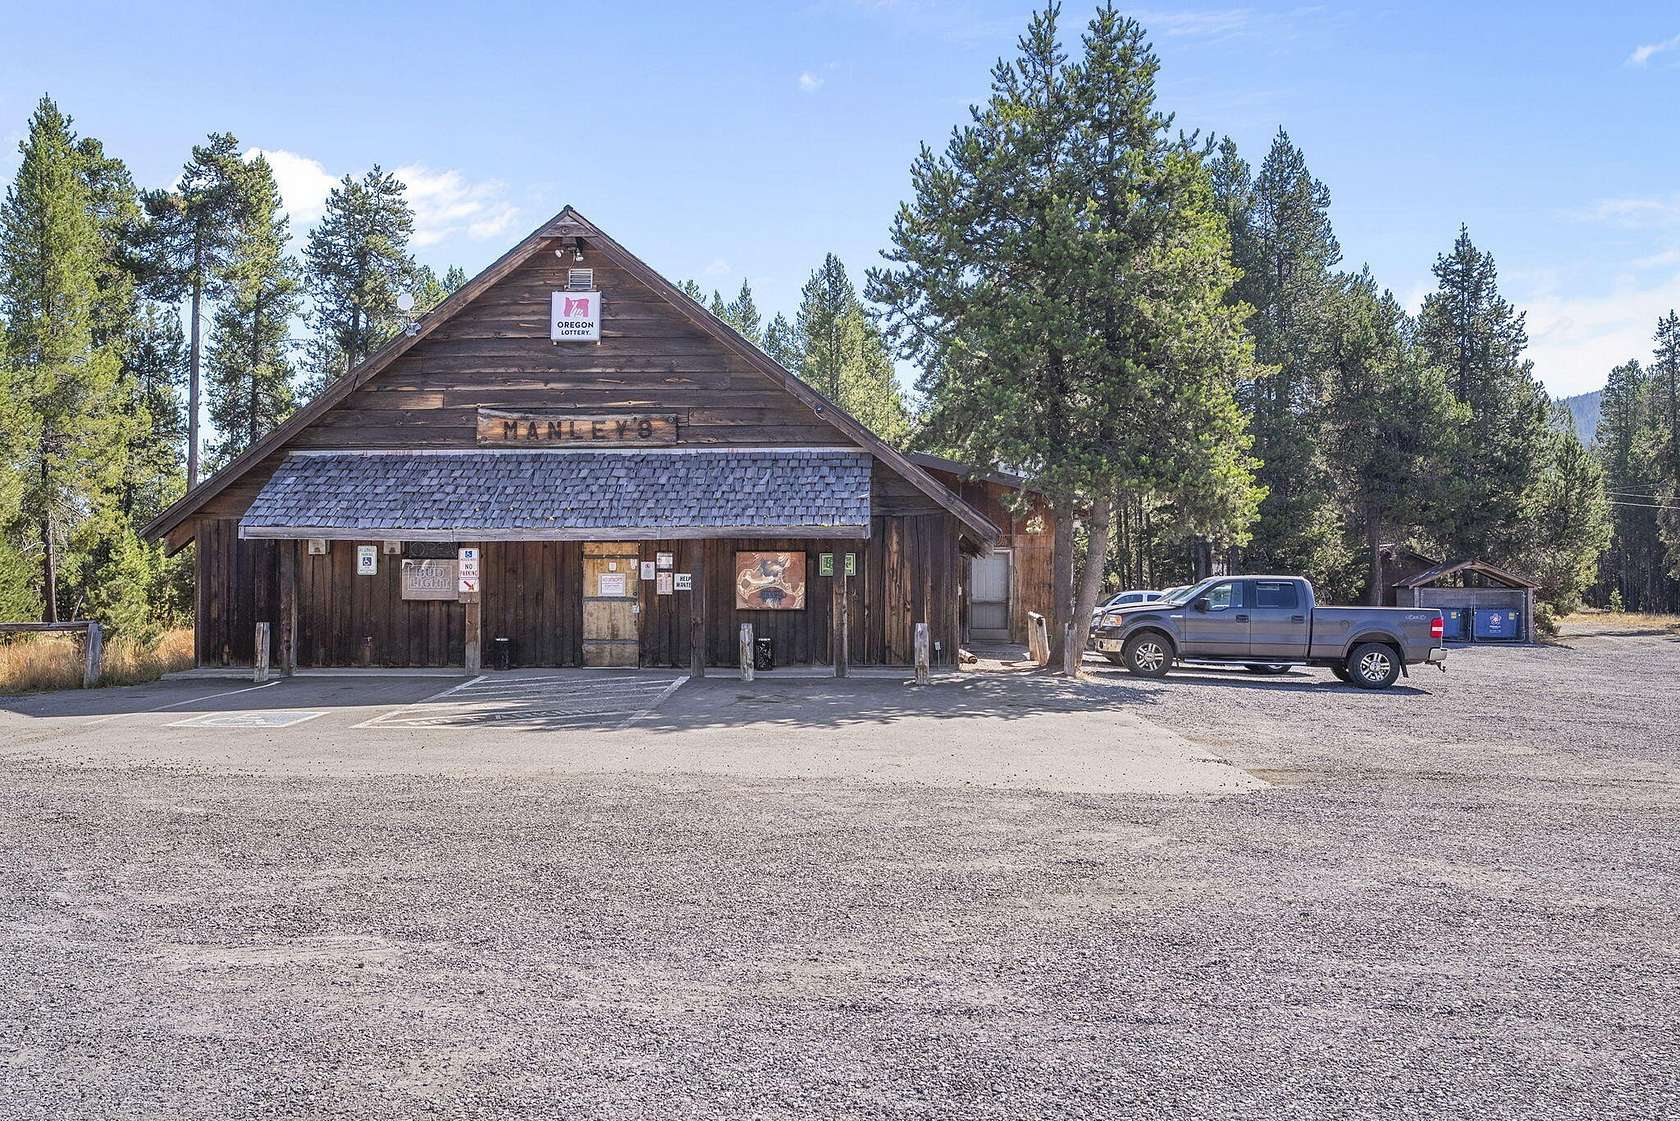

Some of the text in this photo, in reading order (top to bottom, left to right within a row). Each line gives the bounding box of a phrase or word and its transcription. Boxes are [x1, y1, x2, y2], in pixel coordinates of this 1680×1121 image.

[557, 321, 594, 329] OREGON
[503, 418, 653, 440] MANLEY'S
[416, 567, 445, 578] BUD
[410, 578, 449, 589] LIGHT
